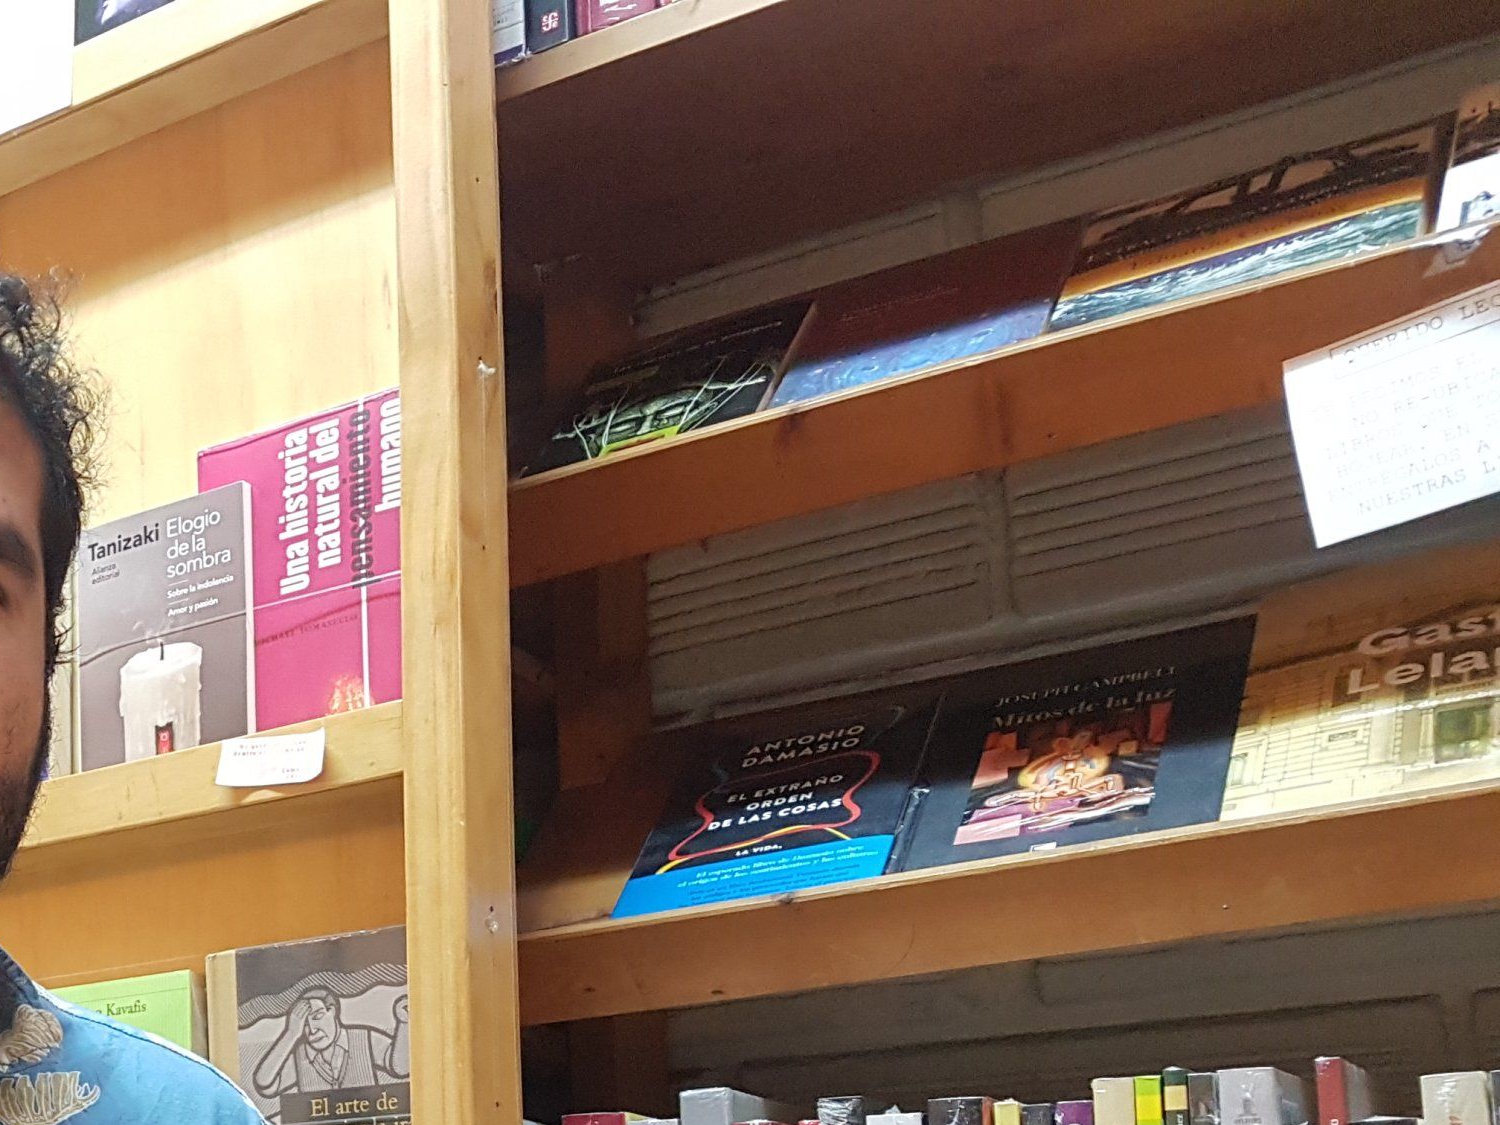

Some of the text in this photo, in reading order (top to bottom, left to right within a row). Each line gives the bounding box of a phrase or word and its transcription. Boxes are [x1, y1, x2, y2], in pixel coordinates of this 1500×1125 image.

[374, 396, 402, 513] humano
[309, 417, 342, 570] natural del
[278, 426, 311, 597] Una historia
[87, 508, 221, 564] Tanizaki Elogio
[166, 548, 232, 580] sombra
[166, 573, 235, 600] Sobre indolencia
[167, 595, 219, 618] Amor pasión
[741, 737, 861, 769] DAMASIO
[746, 724, 866, 757] ANTONIO
[727, 774, 845, 804] EL EXTRAÑO
[746, 792, 815, 812] ORDEN
[707, 798, 844, 832] DE LAS COSAS
[735, 849, 752, 858] LA
[105, 1000, 148, 1018] Kavafis
[310, 1093, 399, 1118] El arte de
